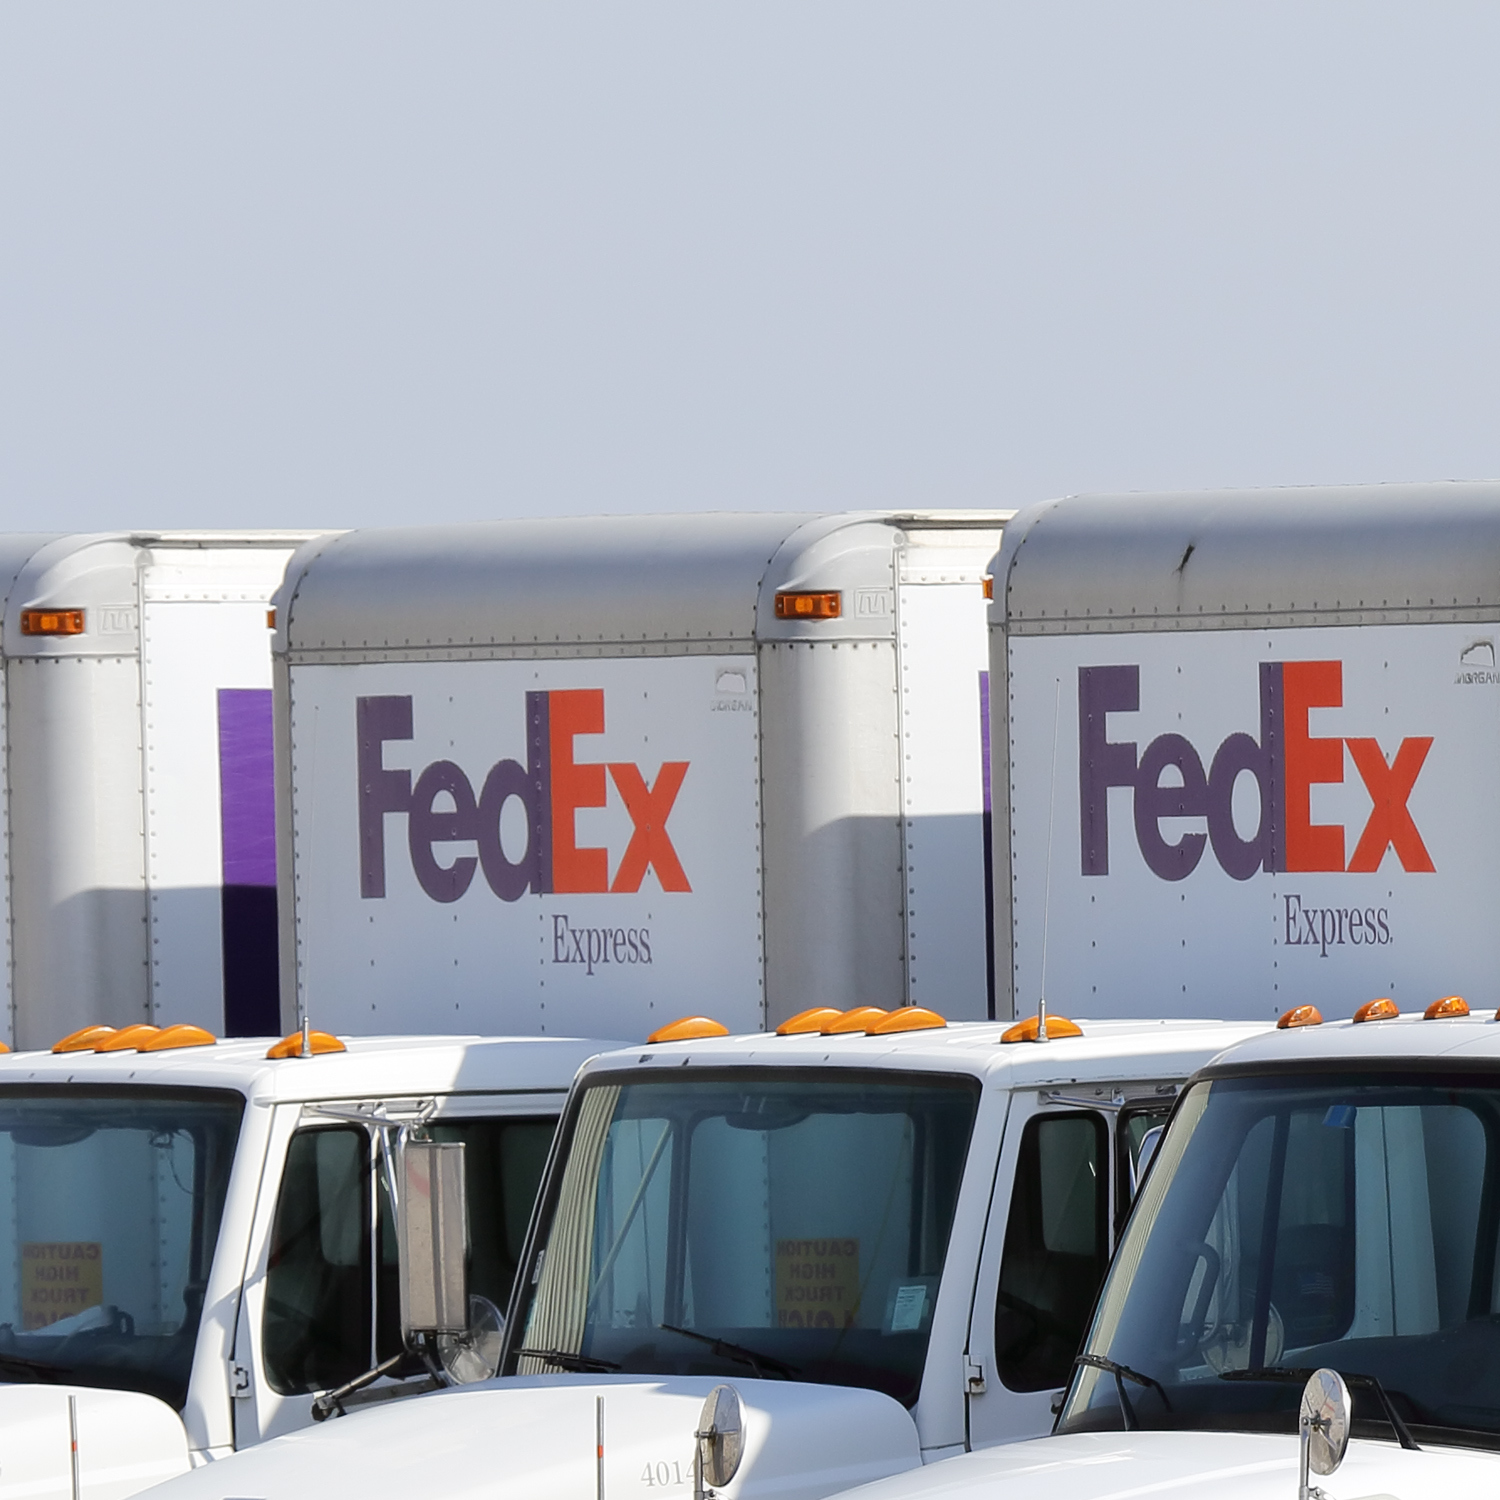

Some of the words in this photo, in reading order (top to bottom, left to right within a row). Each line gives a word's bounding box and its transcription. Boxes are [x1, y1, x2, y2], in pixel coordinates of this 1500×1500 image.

[357, 689, 692, 902] FedEx
[1078, 660, 1435, 881] FedEx
[551, 914, 651, 976] Express
[1284, 894, 1390, 957] Express
